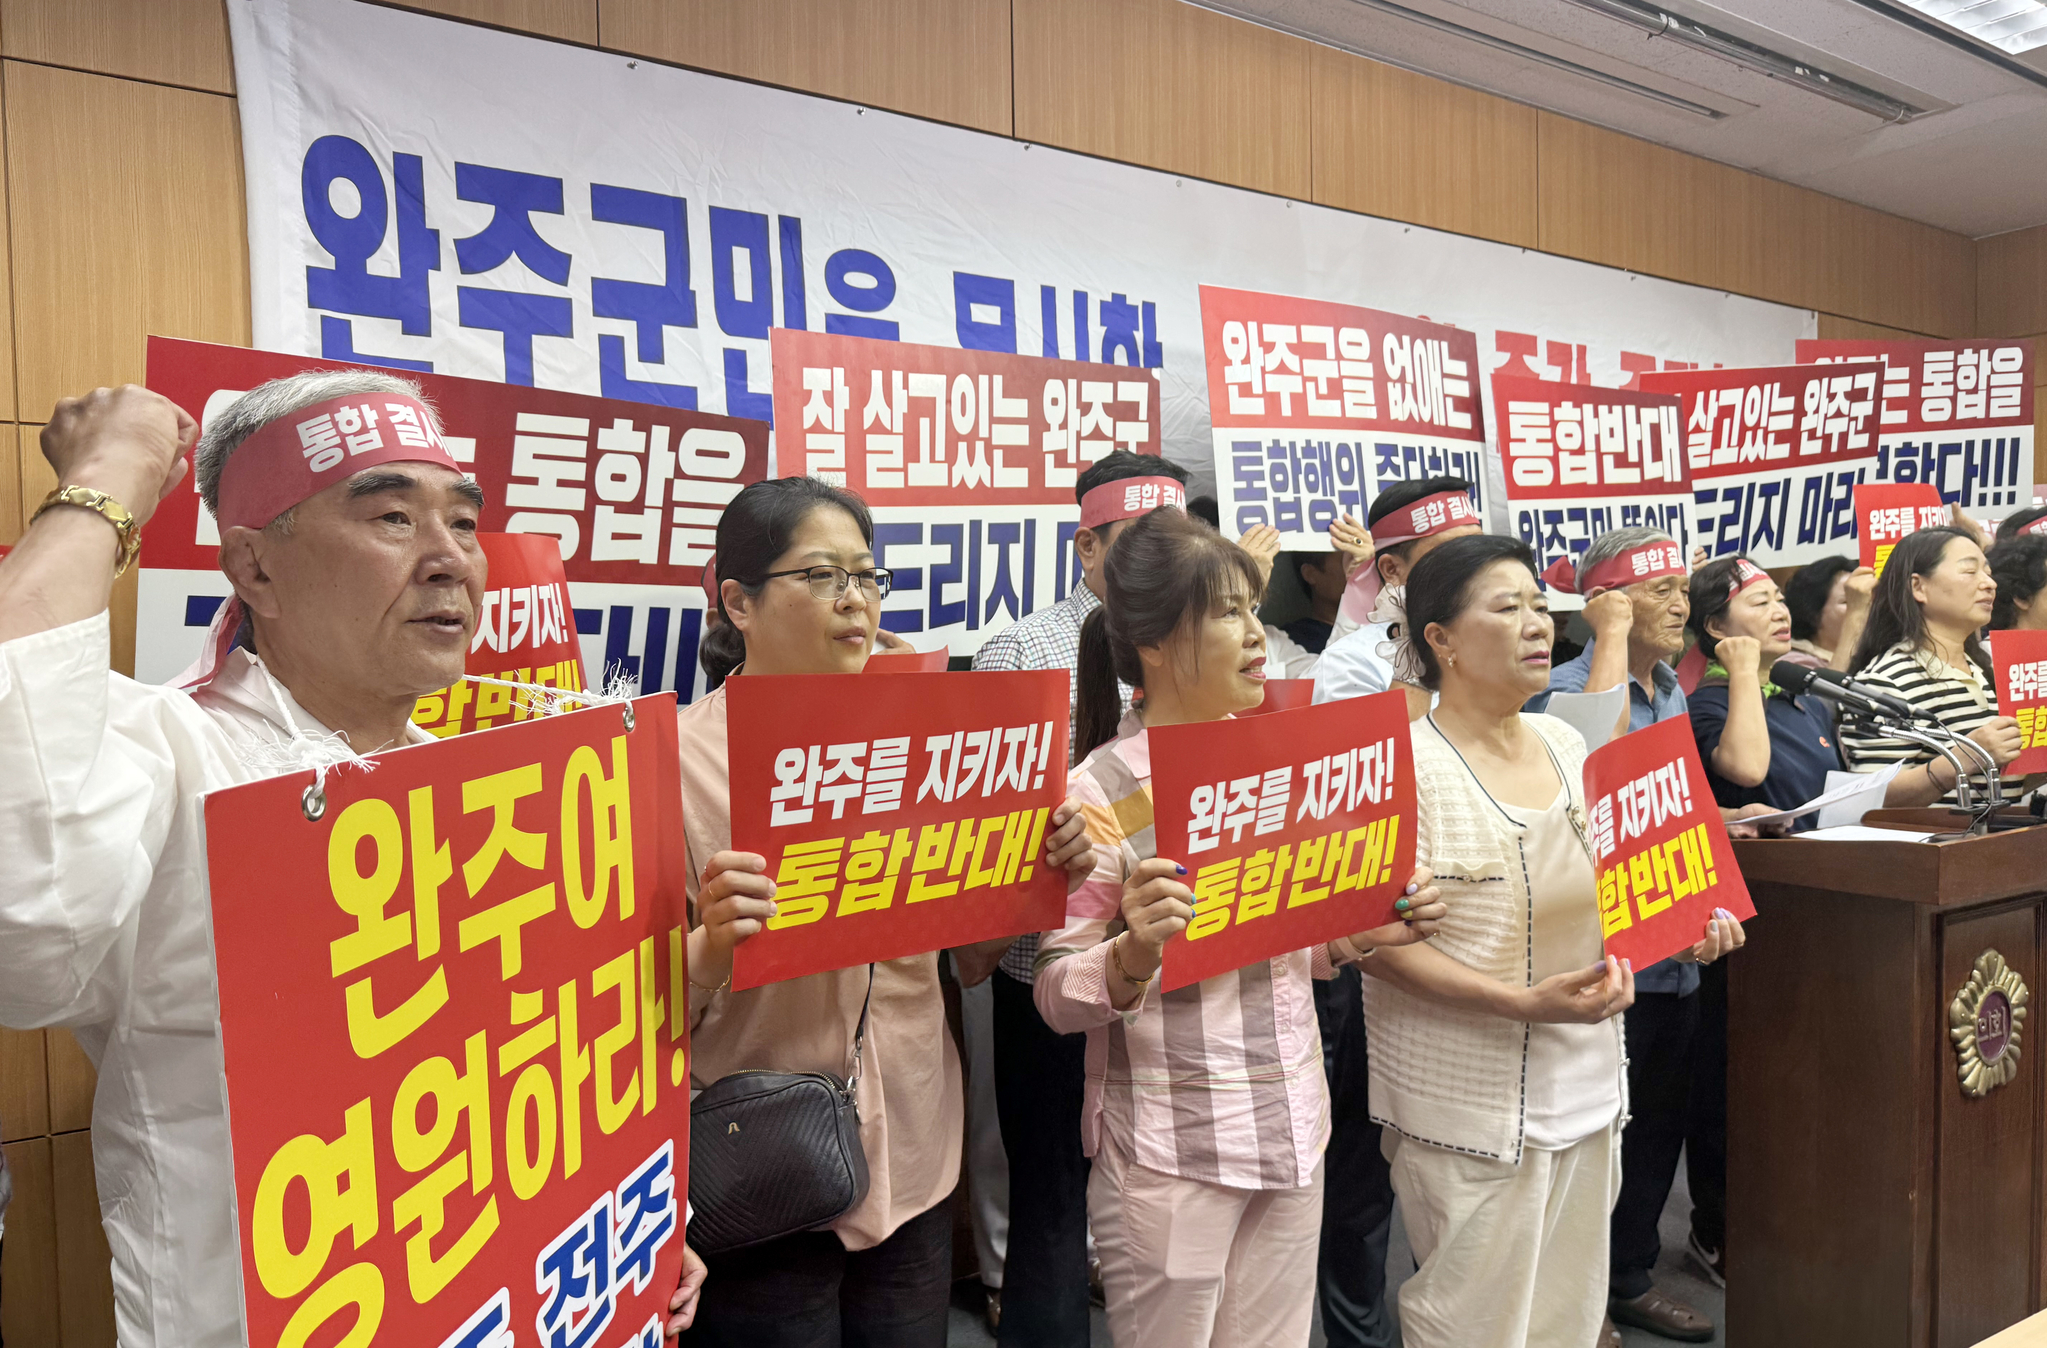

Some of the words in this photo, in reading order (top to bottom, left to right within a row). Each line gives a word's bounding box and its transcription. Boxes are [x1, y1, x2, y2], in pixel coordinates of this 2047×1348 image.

[1222, 320, 1378, 419] 완주군을
[1382, 332, 1473, 430] 없애는
[1687, 382, 1796, 470] 살고있는
[1799, 372, 1877, 456] 완주군
[1921, 346, 2024, 423] 통합을
[296, 403, 384, 473] 통합
[803, 366, 849, 488] 잘
[863, 369, 1030, 490] 살고있는
[1508, 401, 1682, 487] 통합반대
[505, 412, 746, 568] 통합을
[1123, 483, 1160, 512] 통합
[1231, 438, 1370, 536] 통합행위
[1410, 499, 1446, 534] 통합
[1869, 506, 1916, 541] 완주를
[1631, 547, 1665, 577] 통합
[471, 582, 569, 655] 지키자!
[769, 735, 911, 827] 완주를
[915, 720, 1054, 807] 지키자!
[1186, 764, 1294, 855] 완주를
[1295, 737, 1395, 825] 지키자!
[1617, 756, 1693, 844] 지키자!
[327, 734, 635, 1059] 완주여
[766, 806, 1051, 932] 통합반대!
[1185, 814, 1401, 943] 통합반대!
[1597, 822, 1719, 941] 합반대!
[252, 924, 686, 1304] 영원하라!
[537, 1142, 677, 1348] 전주
